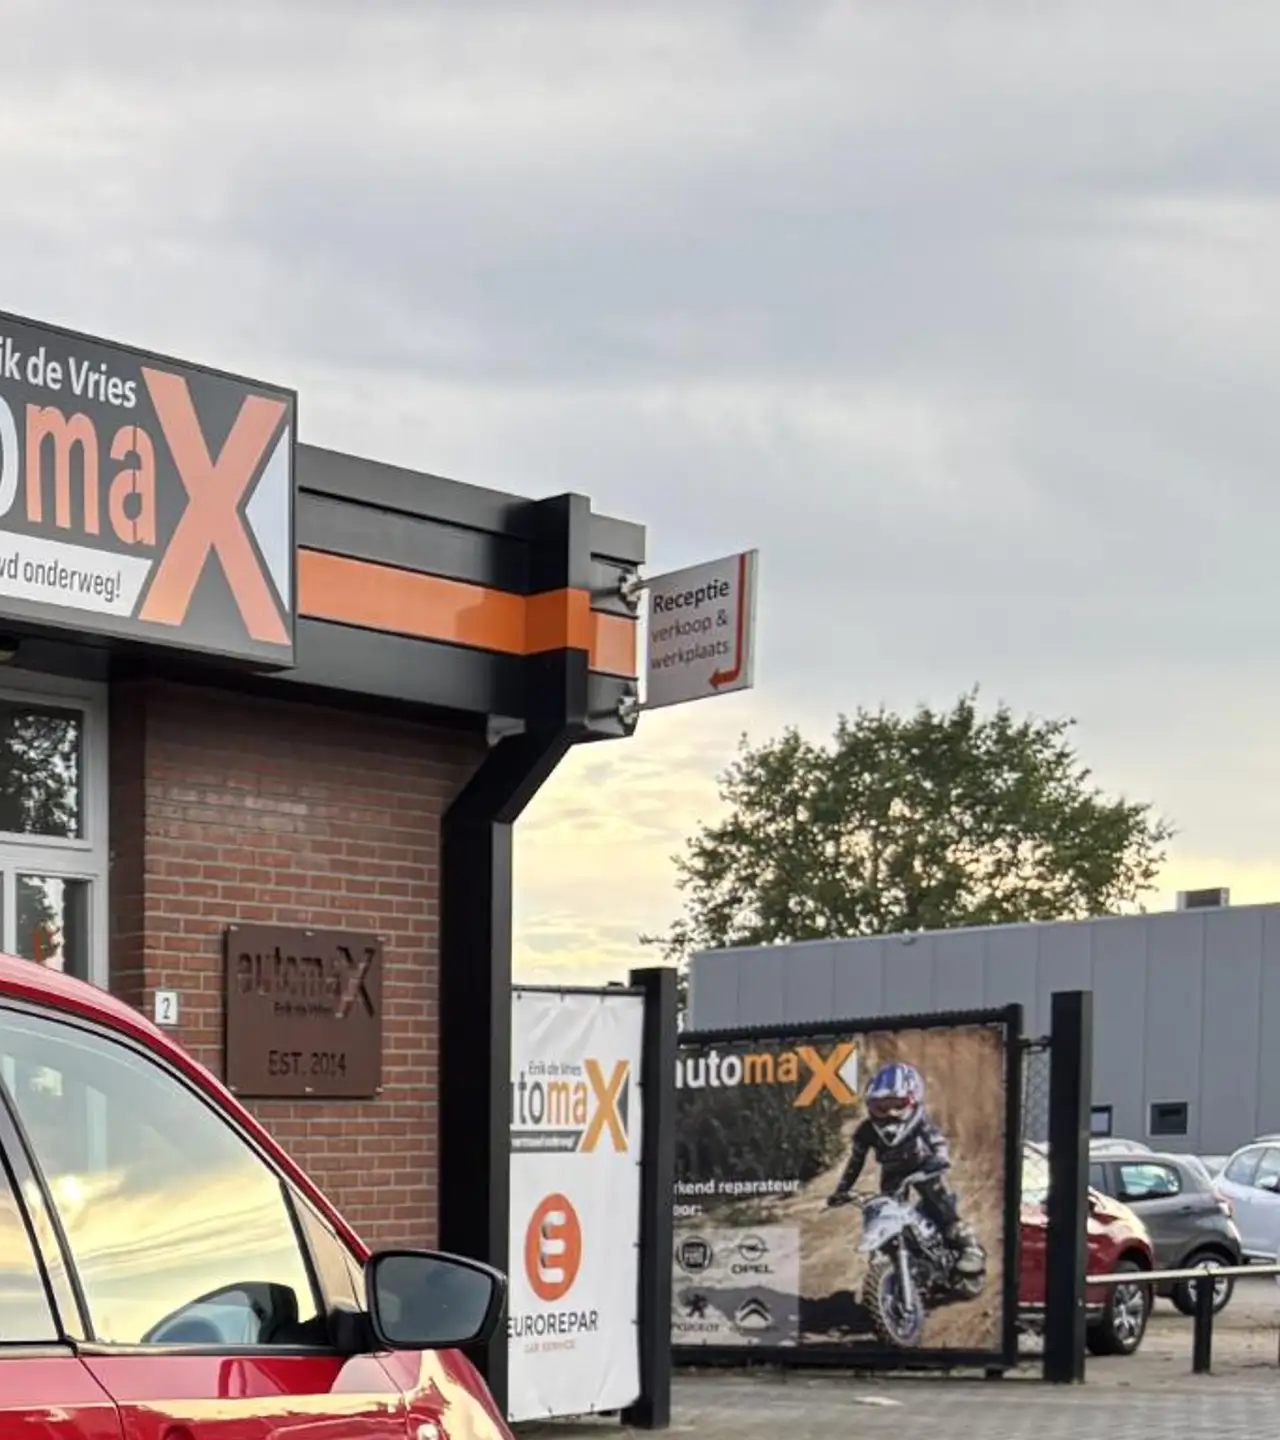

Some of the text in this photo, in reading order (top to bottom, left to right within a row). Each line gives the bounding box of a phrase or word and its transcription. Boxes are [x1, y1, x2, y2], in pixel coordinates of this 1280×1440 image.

[26, 347, 63, 390] de
[68, 356, 137, 409] Vries
[23, 558, 121, 603] onderweg!
[652, 578, 730, 614] Receptie
[651, 609, 728, 644] verkoop &
[651, 639, 729, 670] werkplaats
[509, 1057, 630, 1153] tomaX
[673, 1179, 800, 1196] rkend reparateur
[673, 1204, 703, 1217] oor:
[731, 1263, 774, 1274] OPEL
[507, 1310, 599, 1338] EUROREPAR
